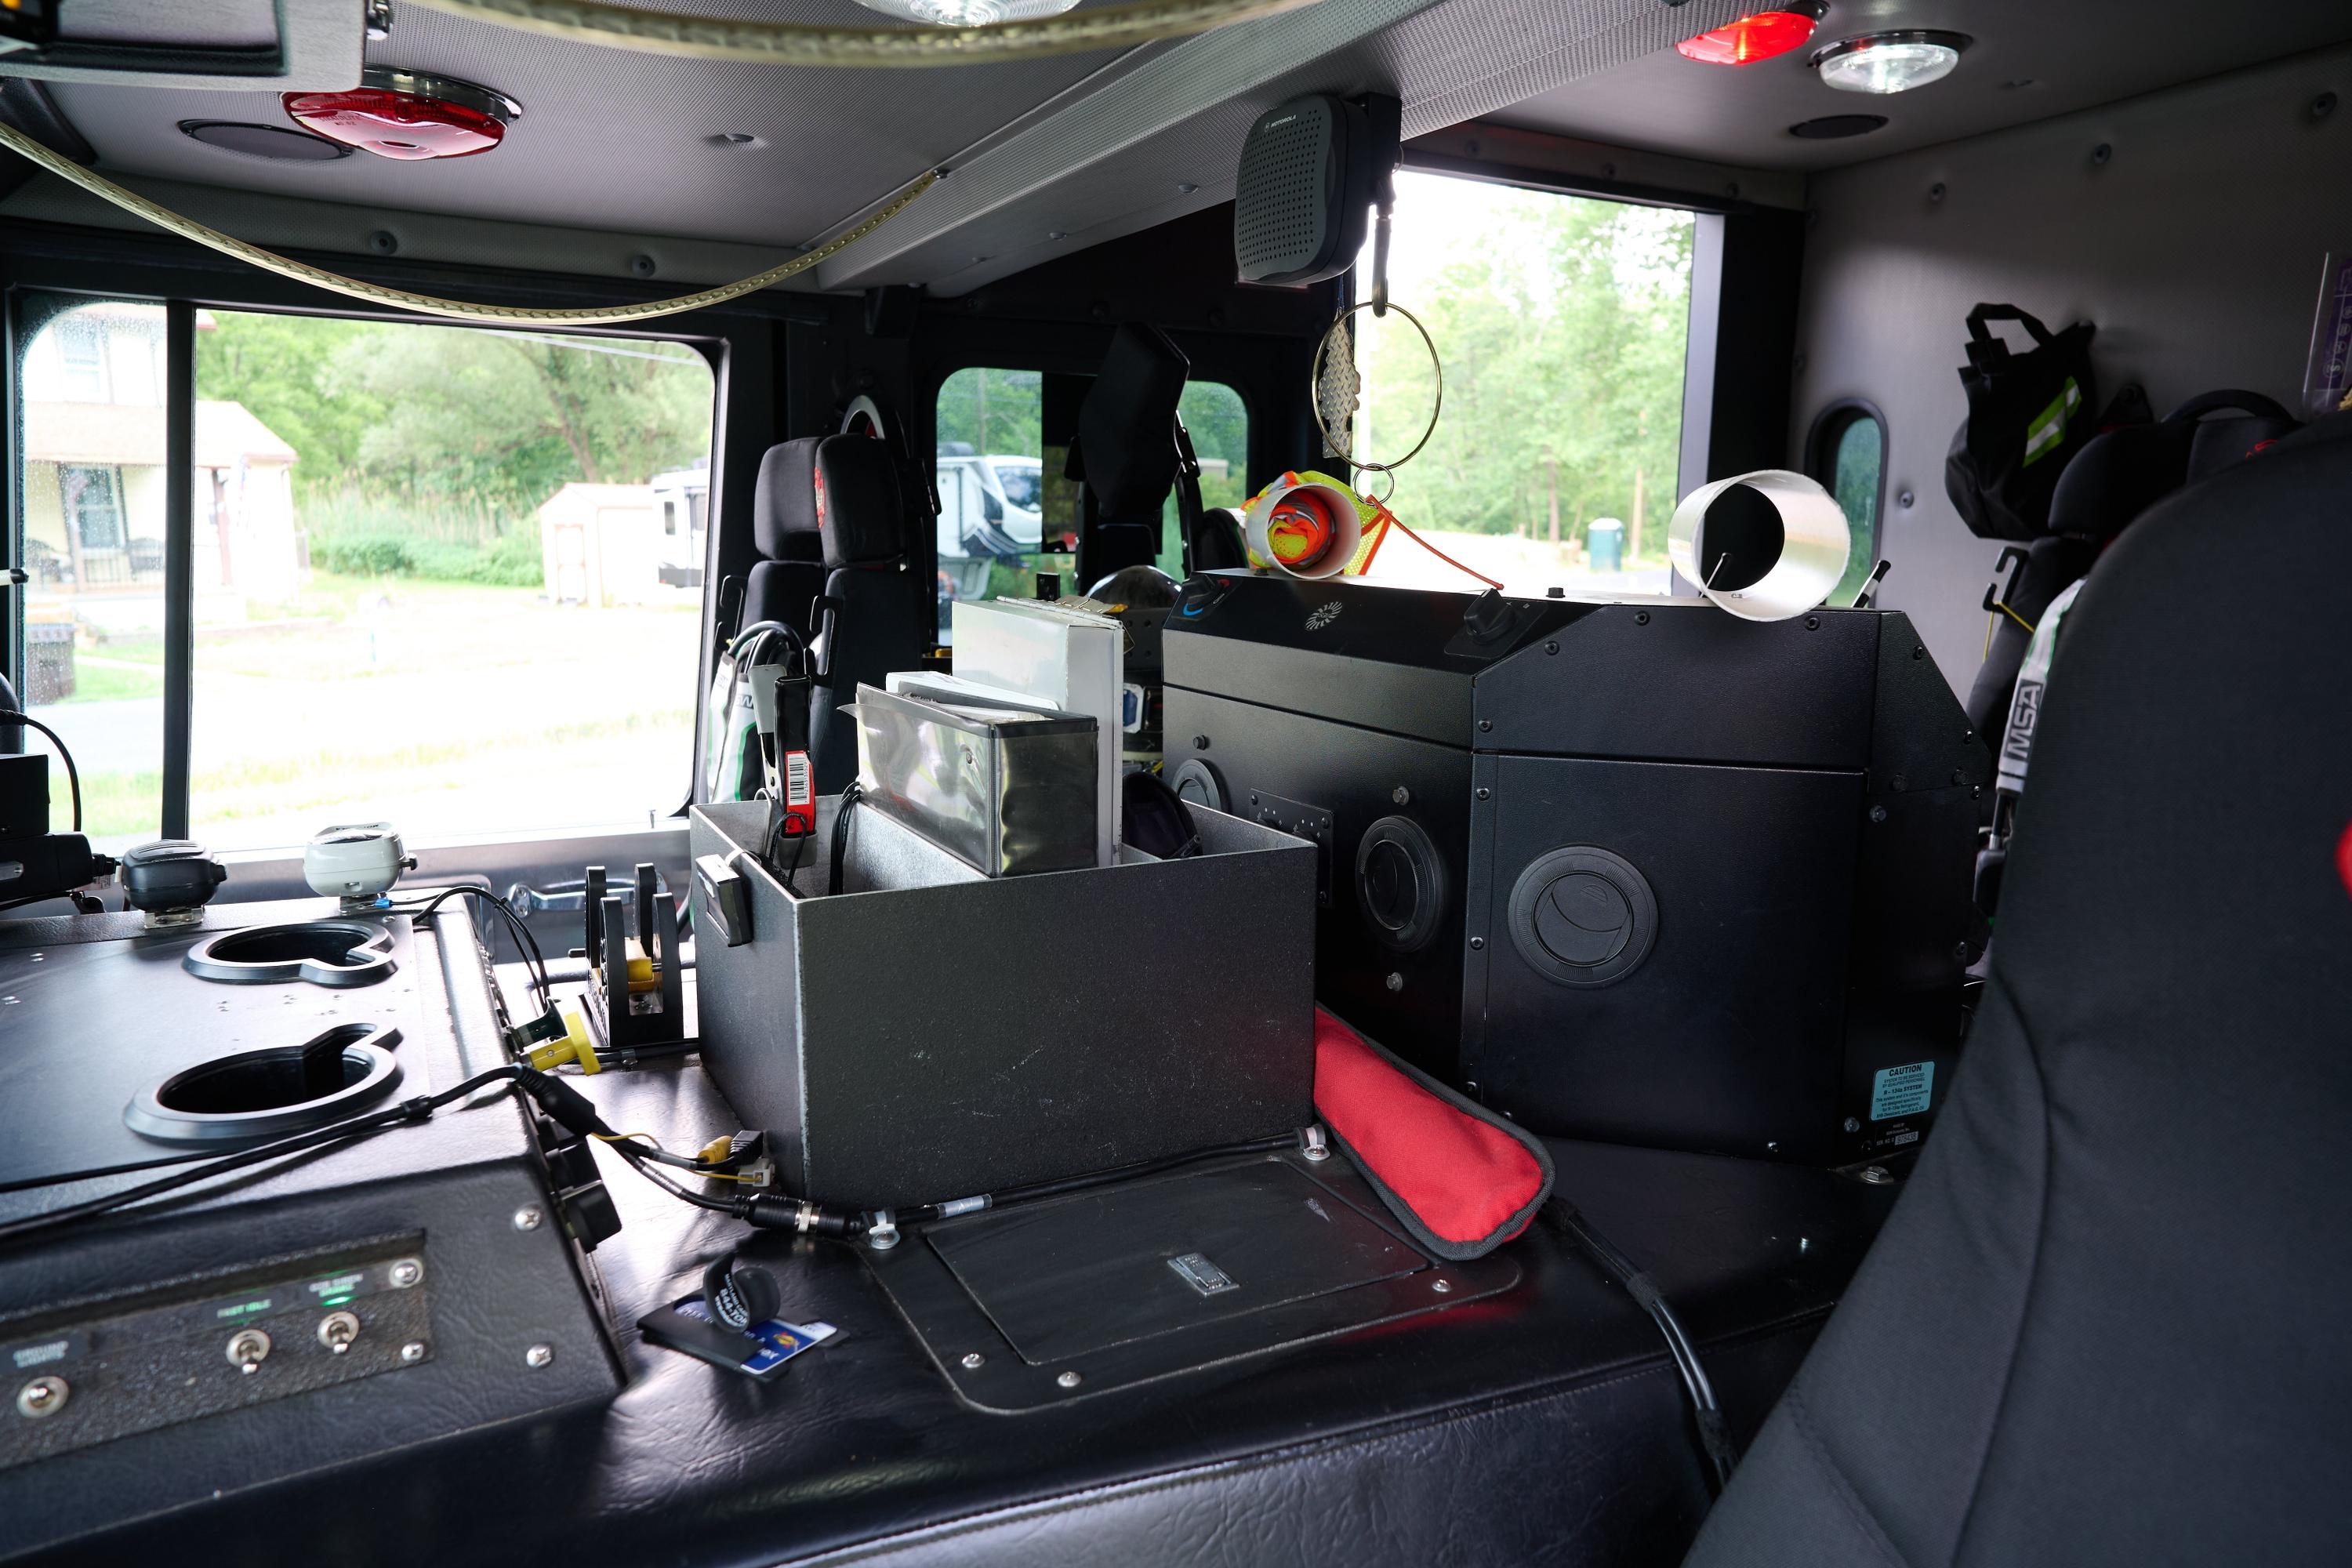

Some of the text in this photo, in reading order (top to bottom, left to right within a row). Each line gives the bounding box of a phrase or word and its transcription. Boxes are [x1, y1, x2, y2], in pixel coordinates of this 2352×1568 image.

[1270, 114, 1296, 127] MOTOROLA
[2007, 684, 2042, 759] MSA
[1889, 1064, 1922, 1077] CAUTION
[724, 1273, 739, 1306] MARYLAND
[245, 1298, 273, 1312] IDLE
[13, 1341, 69, 1361] GROUND
